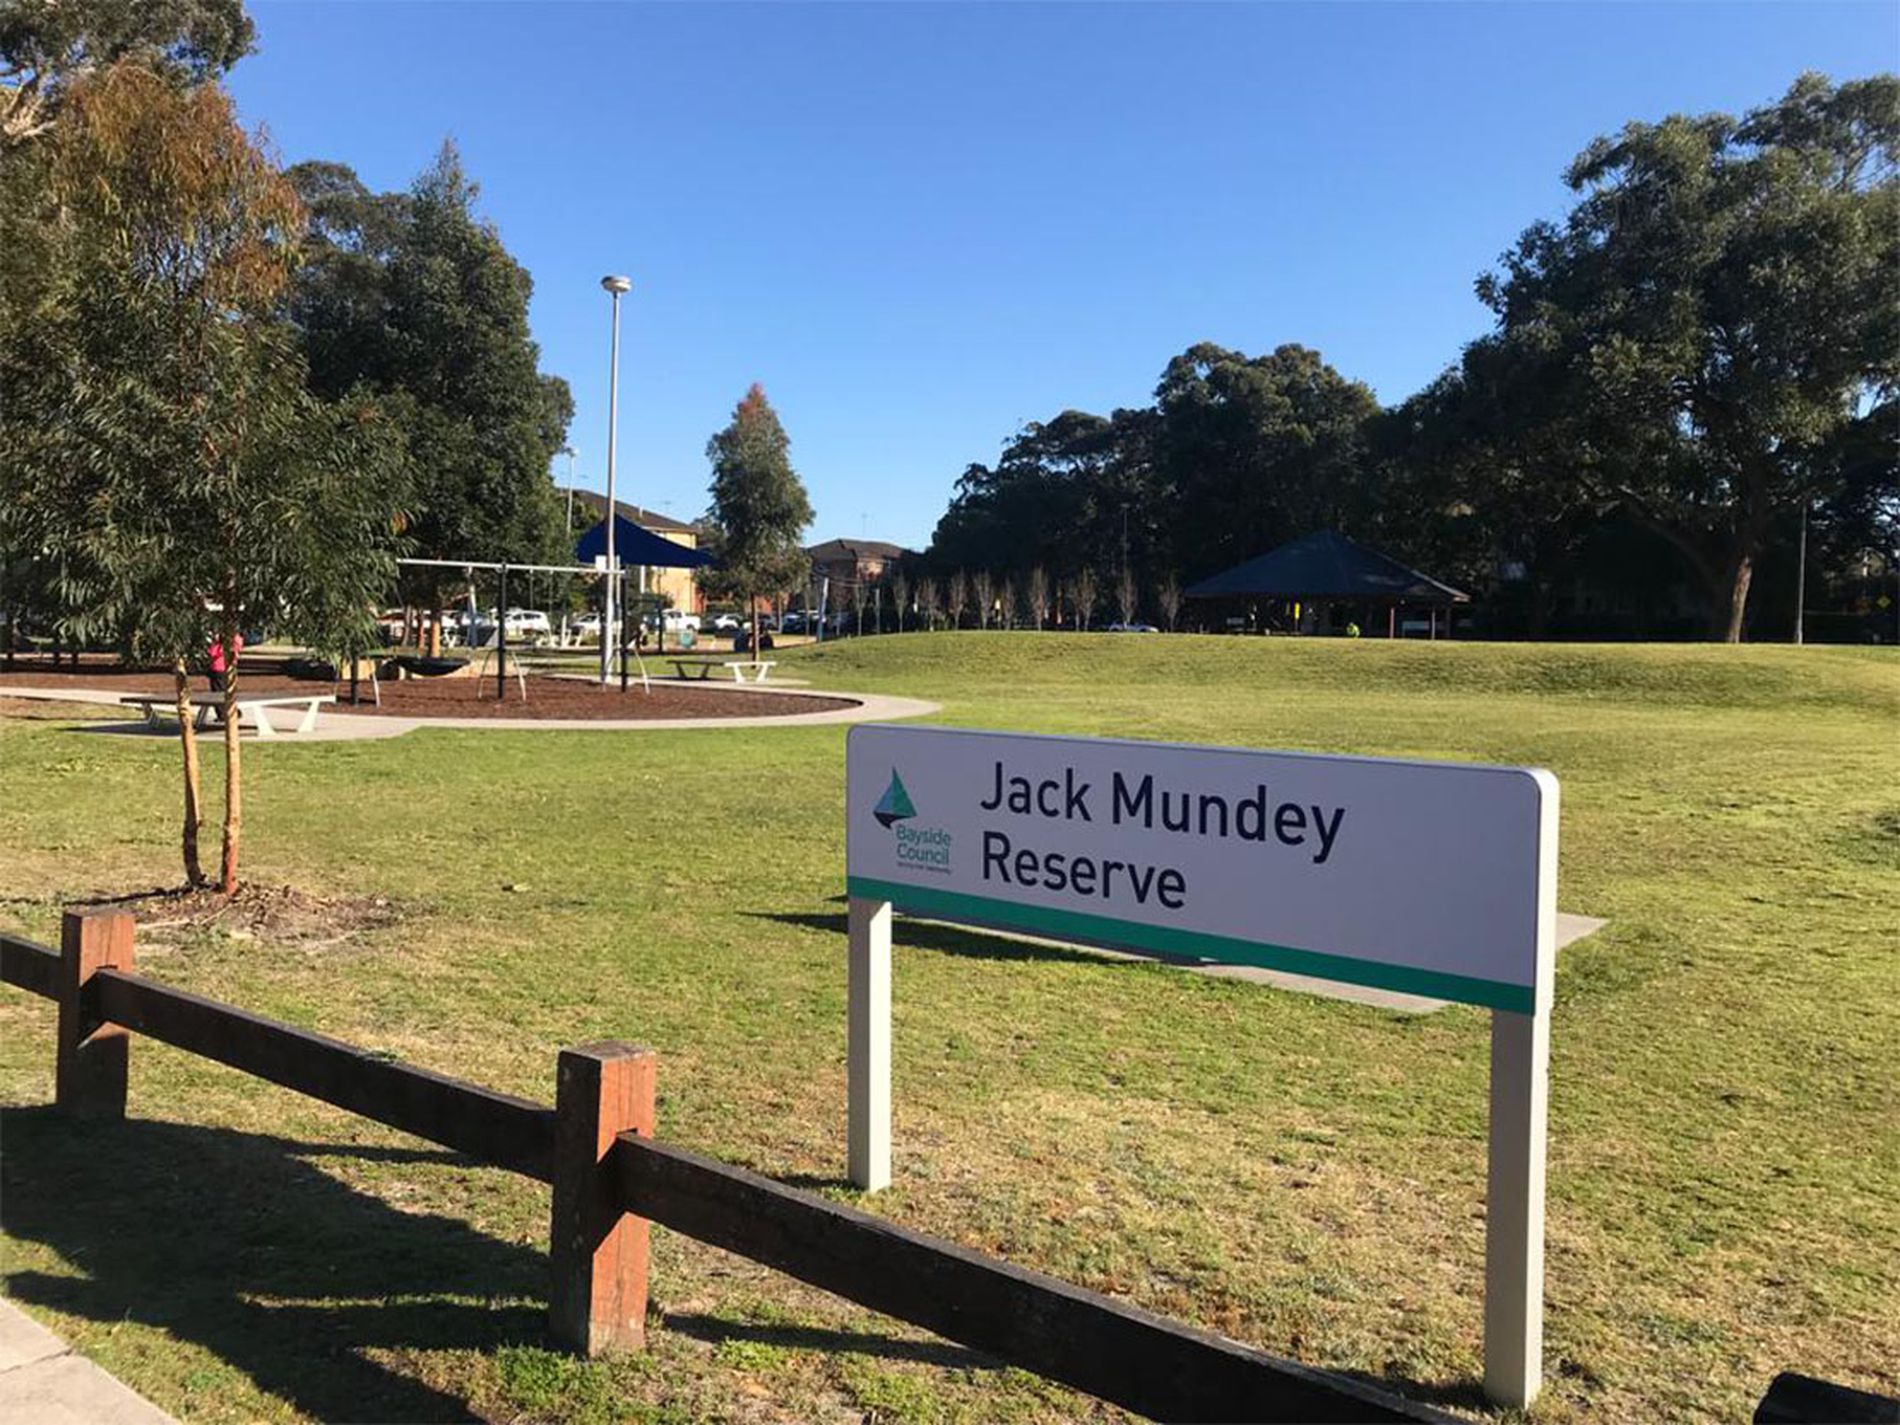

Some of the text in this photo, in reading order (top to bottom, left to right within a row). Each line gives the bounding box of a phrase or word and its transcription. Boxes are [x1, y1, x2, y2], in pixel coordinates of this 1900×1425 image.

[896, 824, 952, 847] Bayside
[980, 761, 1346, 865] Jack Mundey
[897, 843, 949, 865] Council
[983, 830, 1187, 910] Reserve
